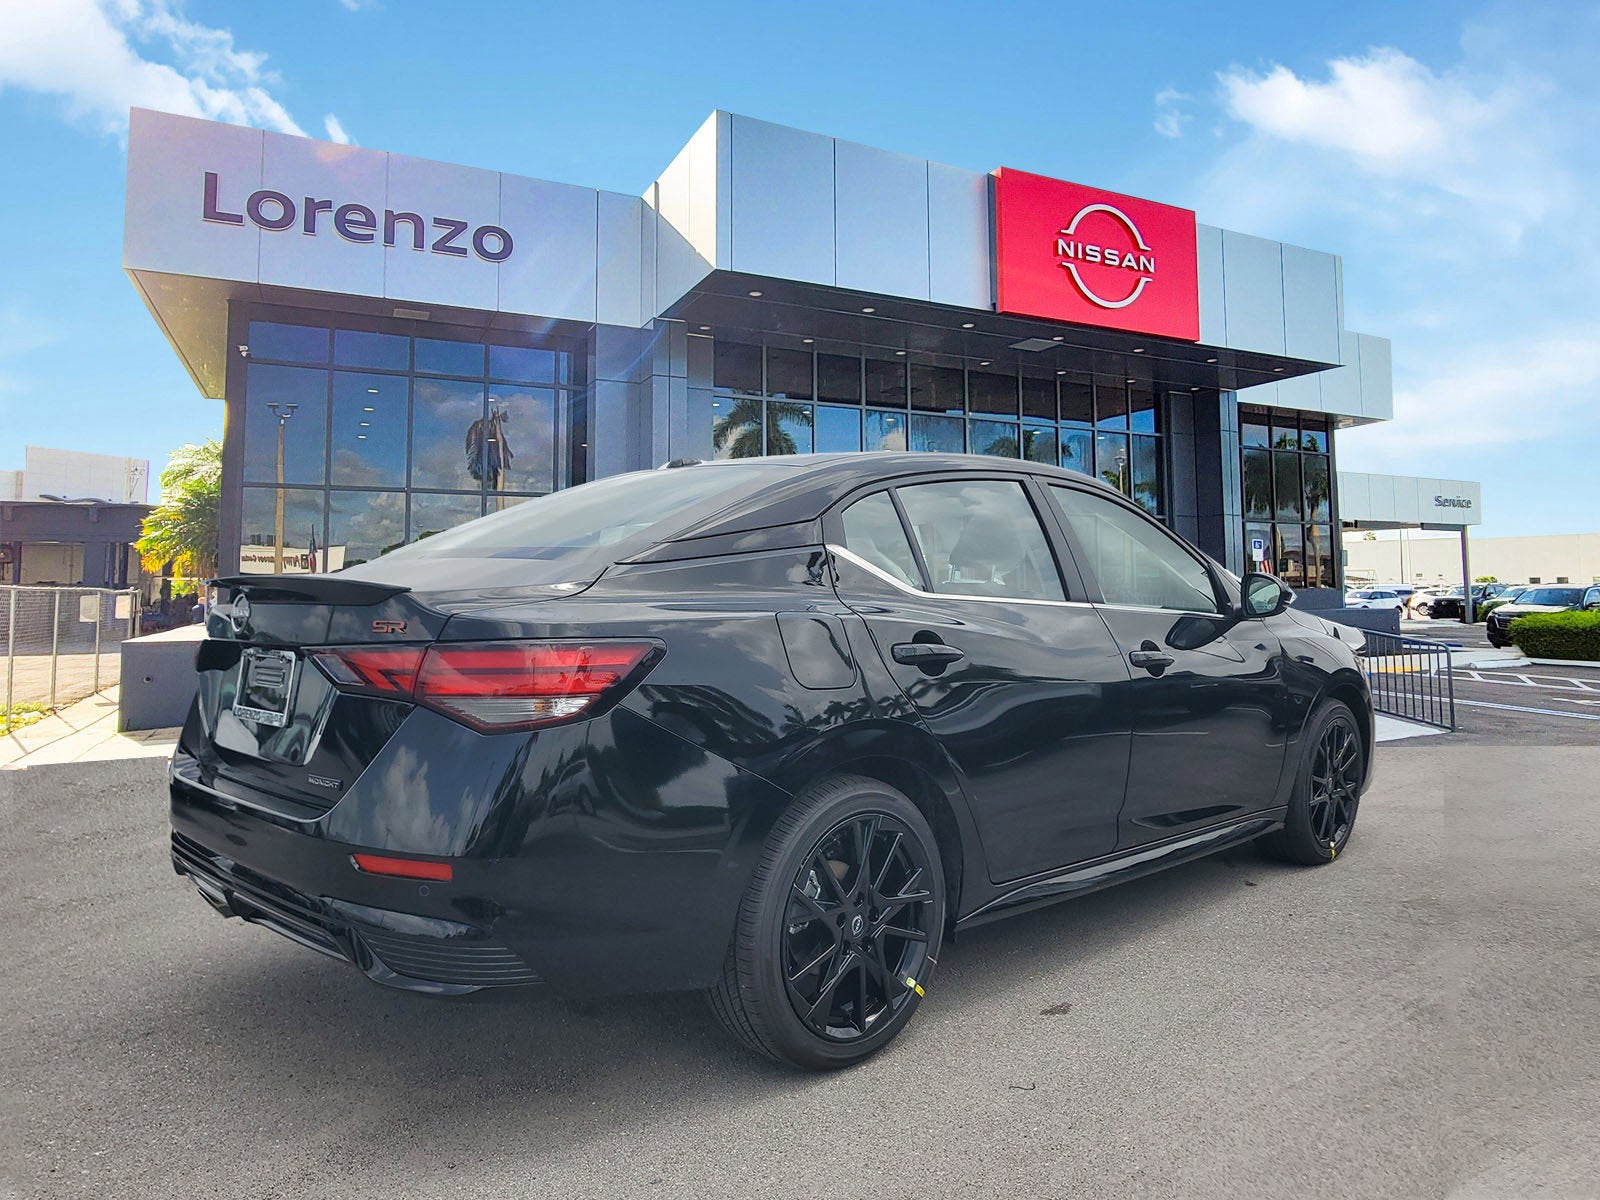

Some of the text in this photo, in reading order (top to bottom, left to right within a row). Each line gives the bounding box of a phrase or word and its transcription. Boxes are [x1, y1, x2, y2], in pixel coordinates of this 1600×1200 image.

[202, 171, 514, 262] Lorenzo
[1057, 238, 1155, 273] NISSAN
[1434, 495, 1472, 509] Service
[372, 620, 405, 634] SR
